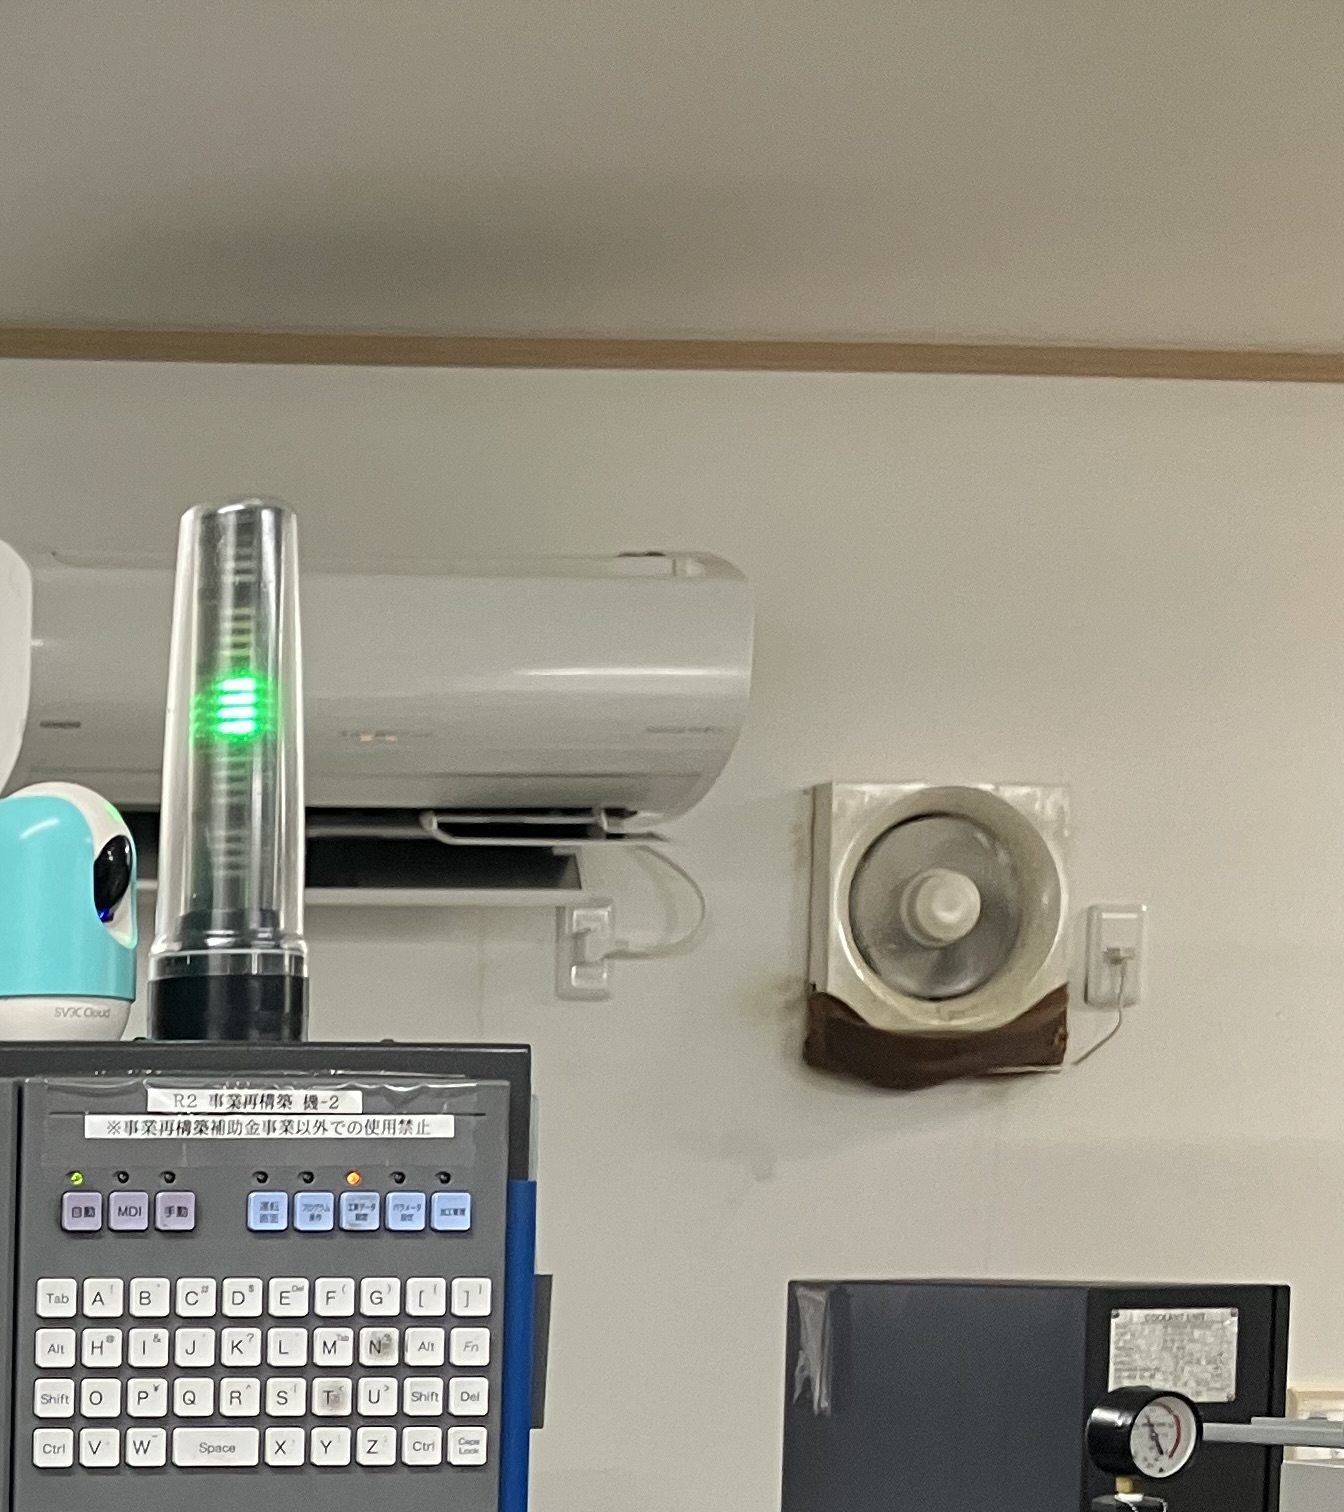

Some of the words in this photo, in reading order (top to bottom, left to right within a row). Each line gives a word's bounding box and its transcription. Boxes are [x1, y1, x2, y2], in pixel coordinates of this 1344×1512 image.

[85, 1007, 111, 1019] Cloud
[174, 1094, 197, 1108] R2
[210, 1094, 292, 1110] 事業再構築
[107, 1119, 430, 1137] ※事業再構築補助金事業以外での使用禁止
[71, 1207, 96, 1218] 自動
[118, 1206, 142, 1217] MDI
[165, 1207, 188, 1218] 手動
[46, 1293, 69, 1304] Tab
[92, 1292, 104, 1305] A
[140, 1291, 151, 1305] B
[185, 1291, 198, 1305] C
[233, 1291, 245, 1305] D
[280, 1291, 291, 1305] E
[327, 1291, 336, 1304] F
[370, 1291, 383, 1305] G
[48, 1343, 65, 1354] Alt
[92, 1341, 103, 1355] H
[232, 1340, 244, 1354] K
[323, 1340, 337, 1354] M
[418, 1341, 435, 1352] Alt
[463, 1342, 480, 1353] Fn
[41, 1392, 69, 1405] Shift
[138, 1392, 149, 1405] P
[411, 1390, 440, 1403] Shift
[460, 1390, 480, 1402] Del
[42, 1442, 65, 1454] Ctrl
[133, 1440, 151, 1454] W
[199, 1442, 236, 1455] Space
[274, 1440, 286, 1454] X
